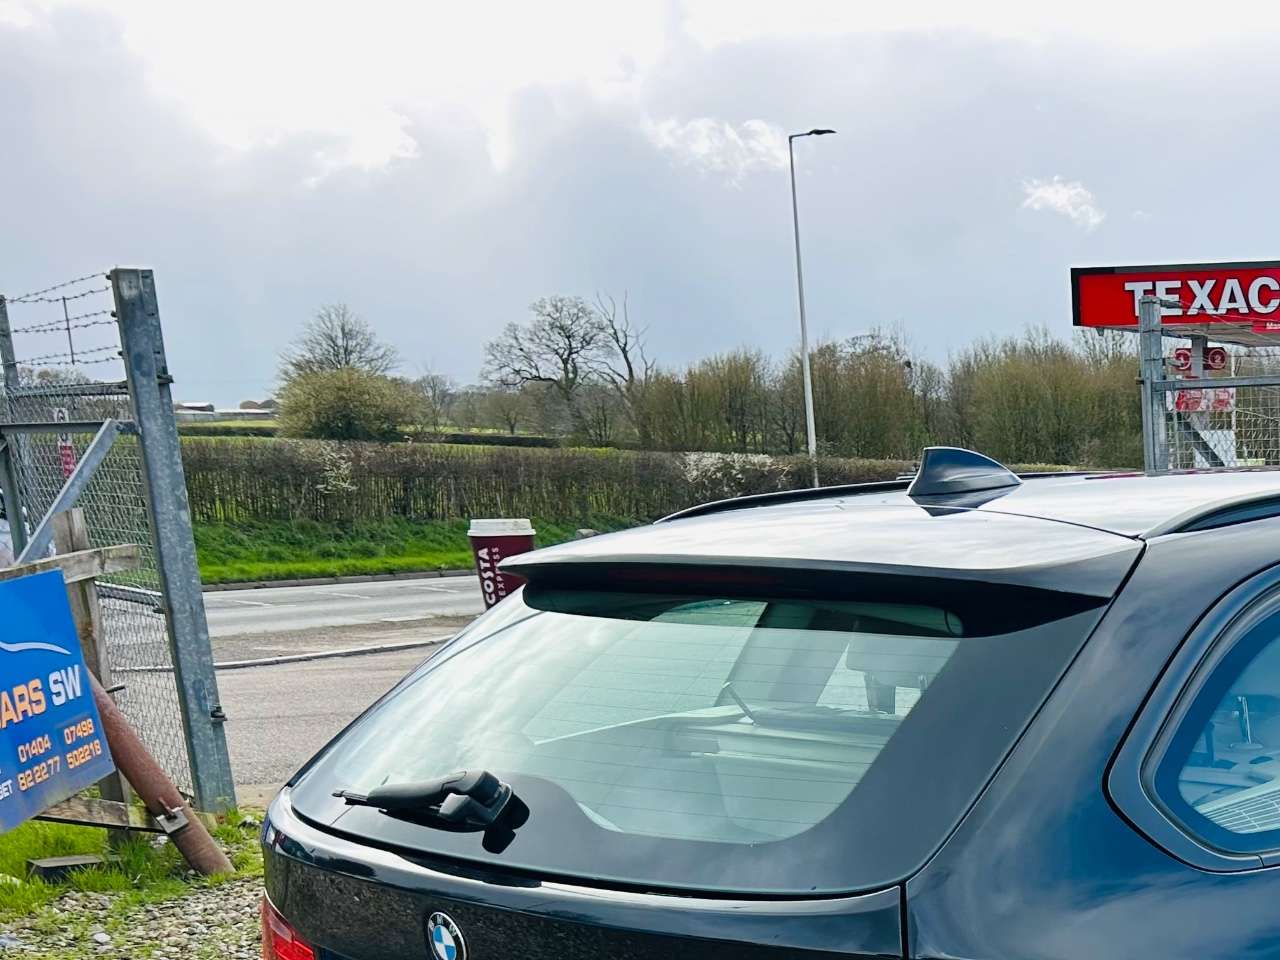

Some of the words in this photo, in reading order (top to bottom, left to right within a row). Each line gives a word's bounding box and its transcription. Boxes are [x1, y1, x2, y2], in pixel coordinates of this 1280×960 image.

[478, 547, 496, 605] COSTA
[0, 678, 46, 729] ARS
[49, 664, 82, 706] SW
[18, 733, 51, 763] 01404
